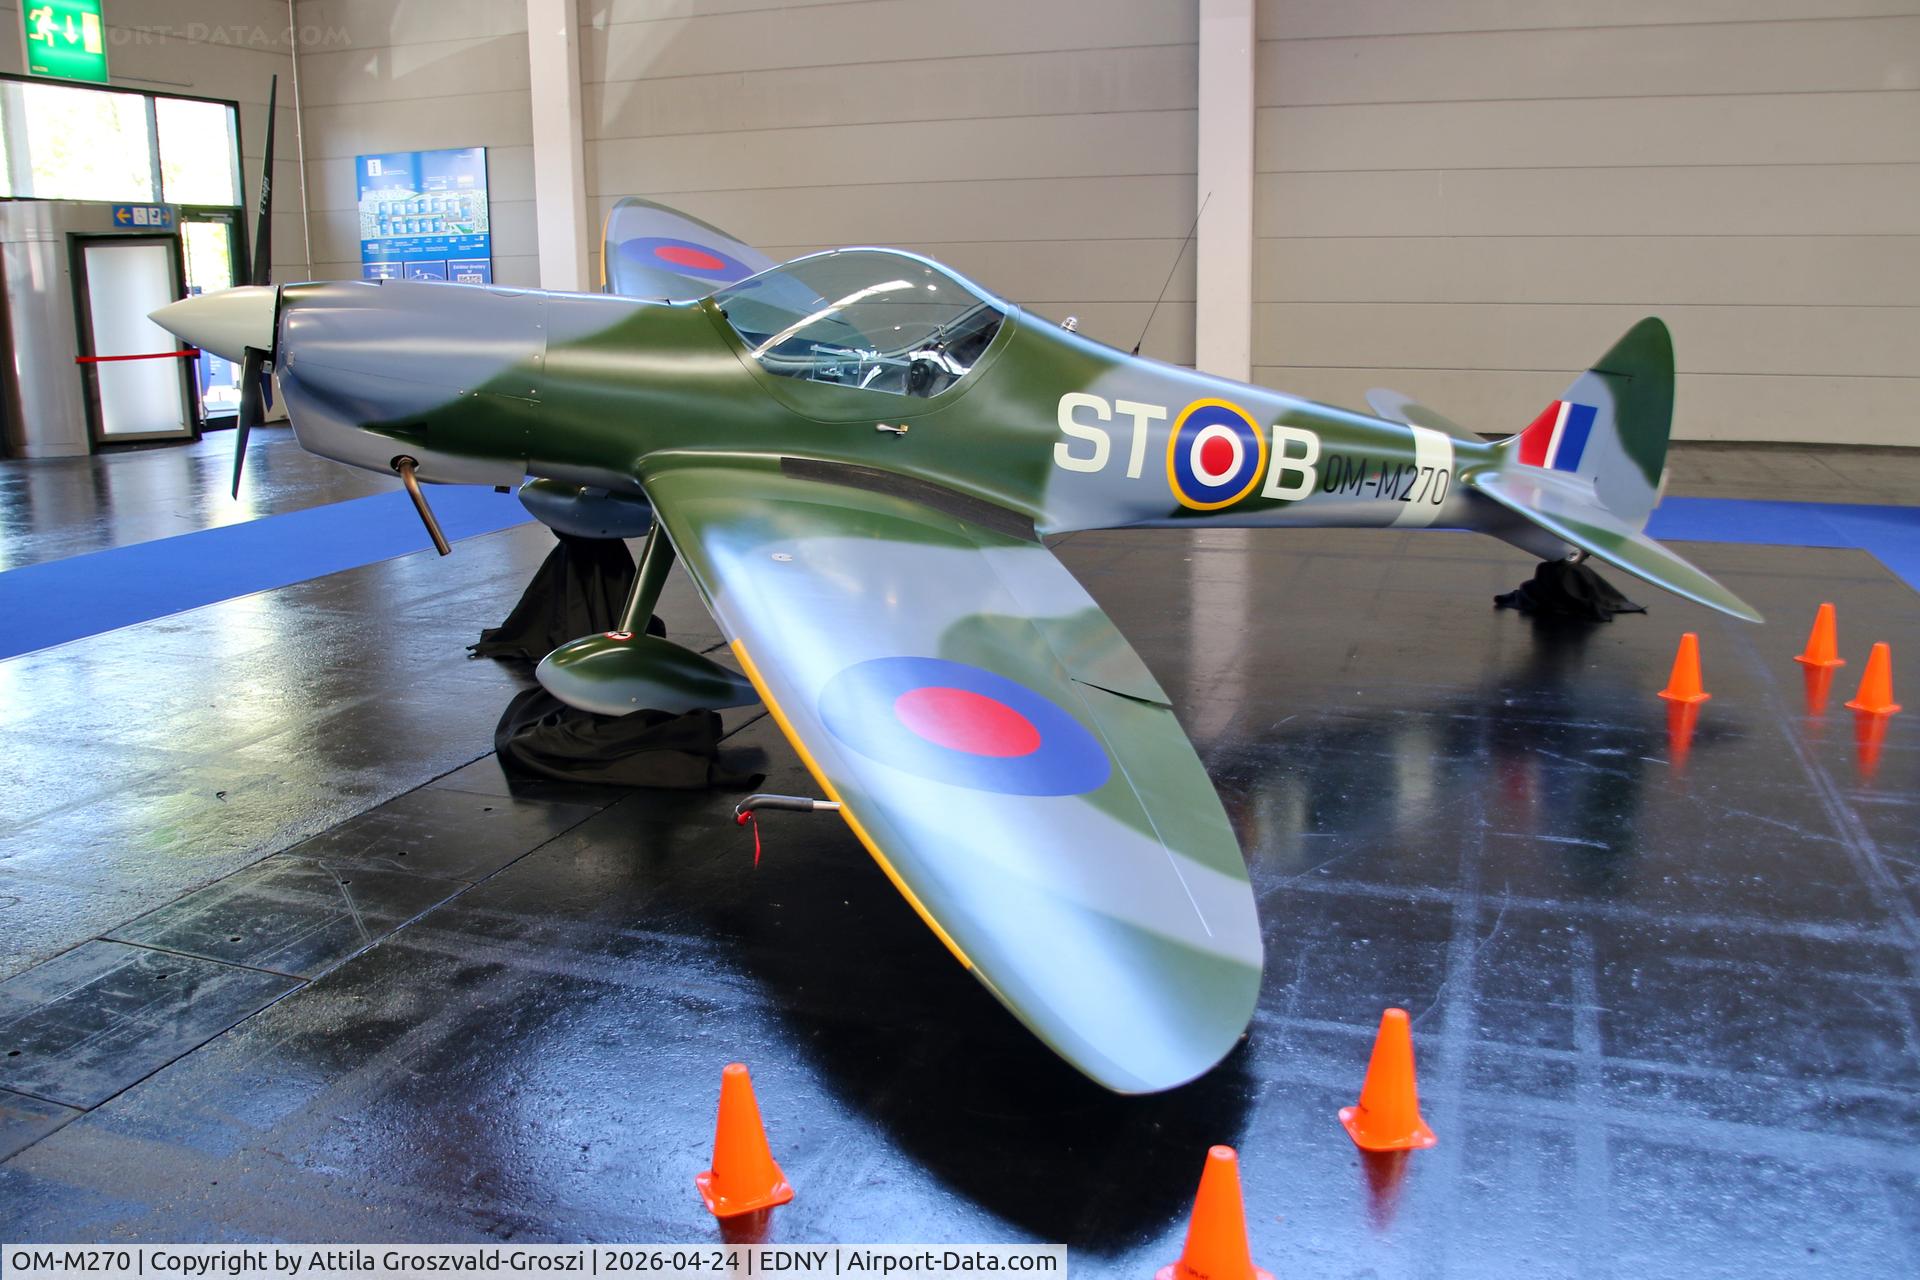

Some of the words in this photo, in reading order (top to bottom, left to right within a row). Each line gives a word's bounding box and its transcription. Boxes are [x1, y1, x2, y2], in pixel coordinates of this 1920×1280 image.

[1053, 392, 1168, 479] ST
[1260, 424, 1320, 501] B
[1323, 454, 1450, 506] OM-M270
